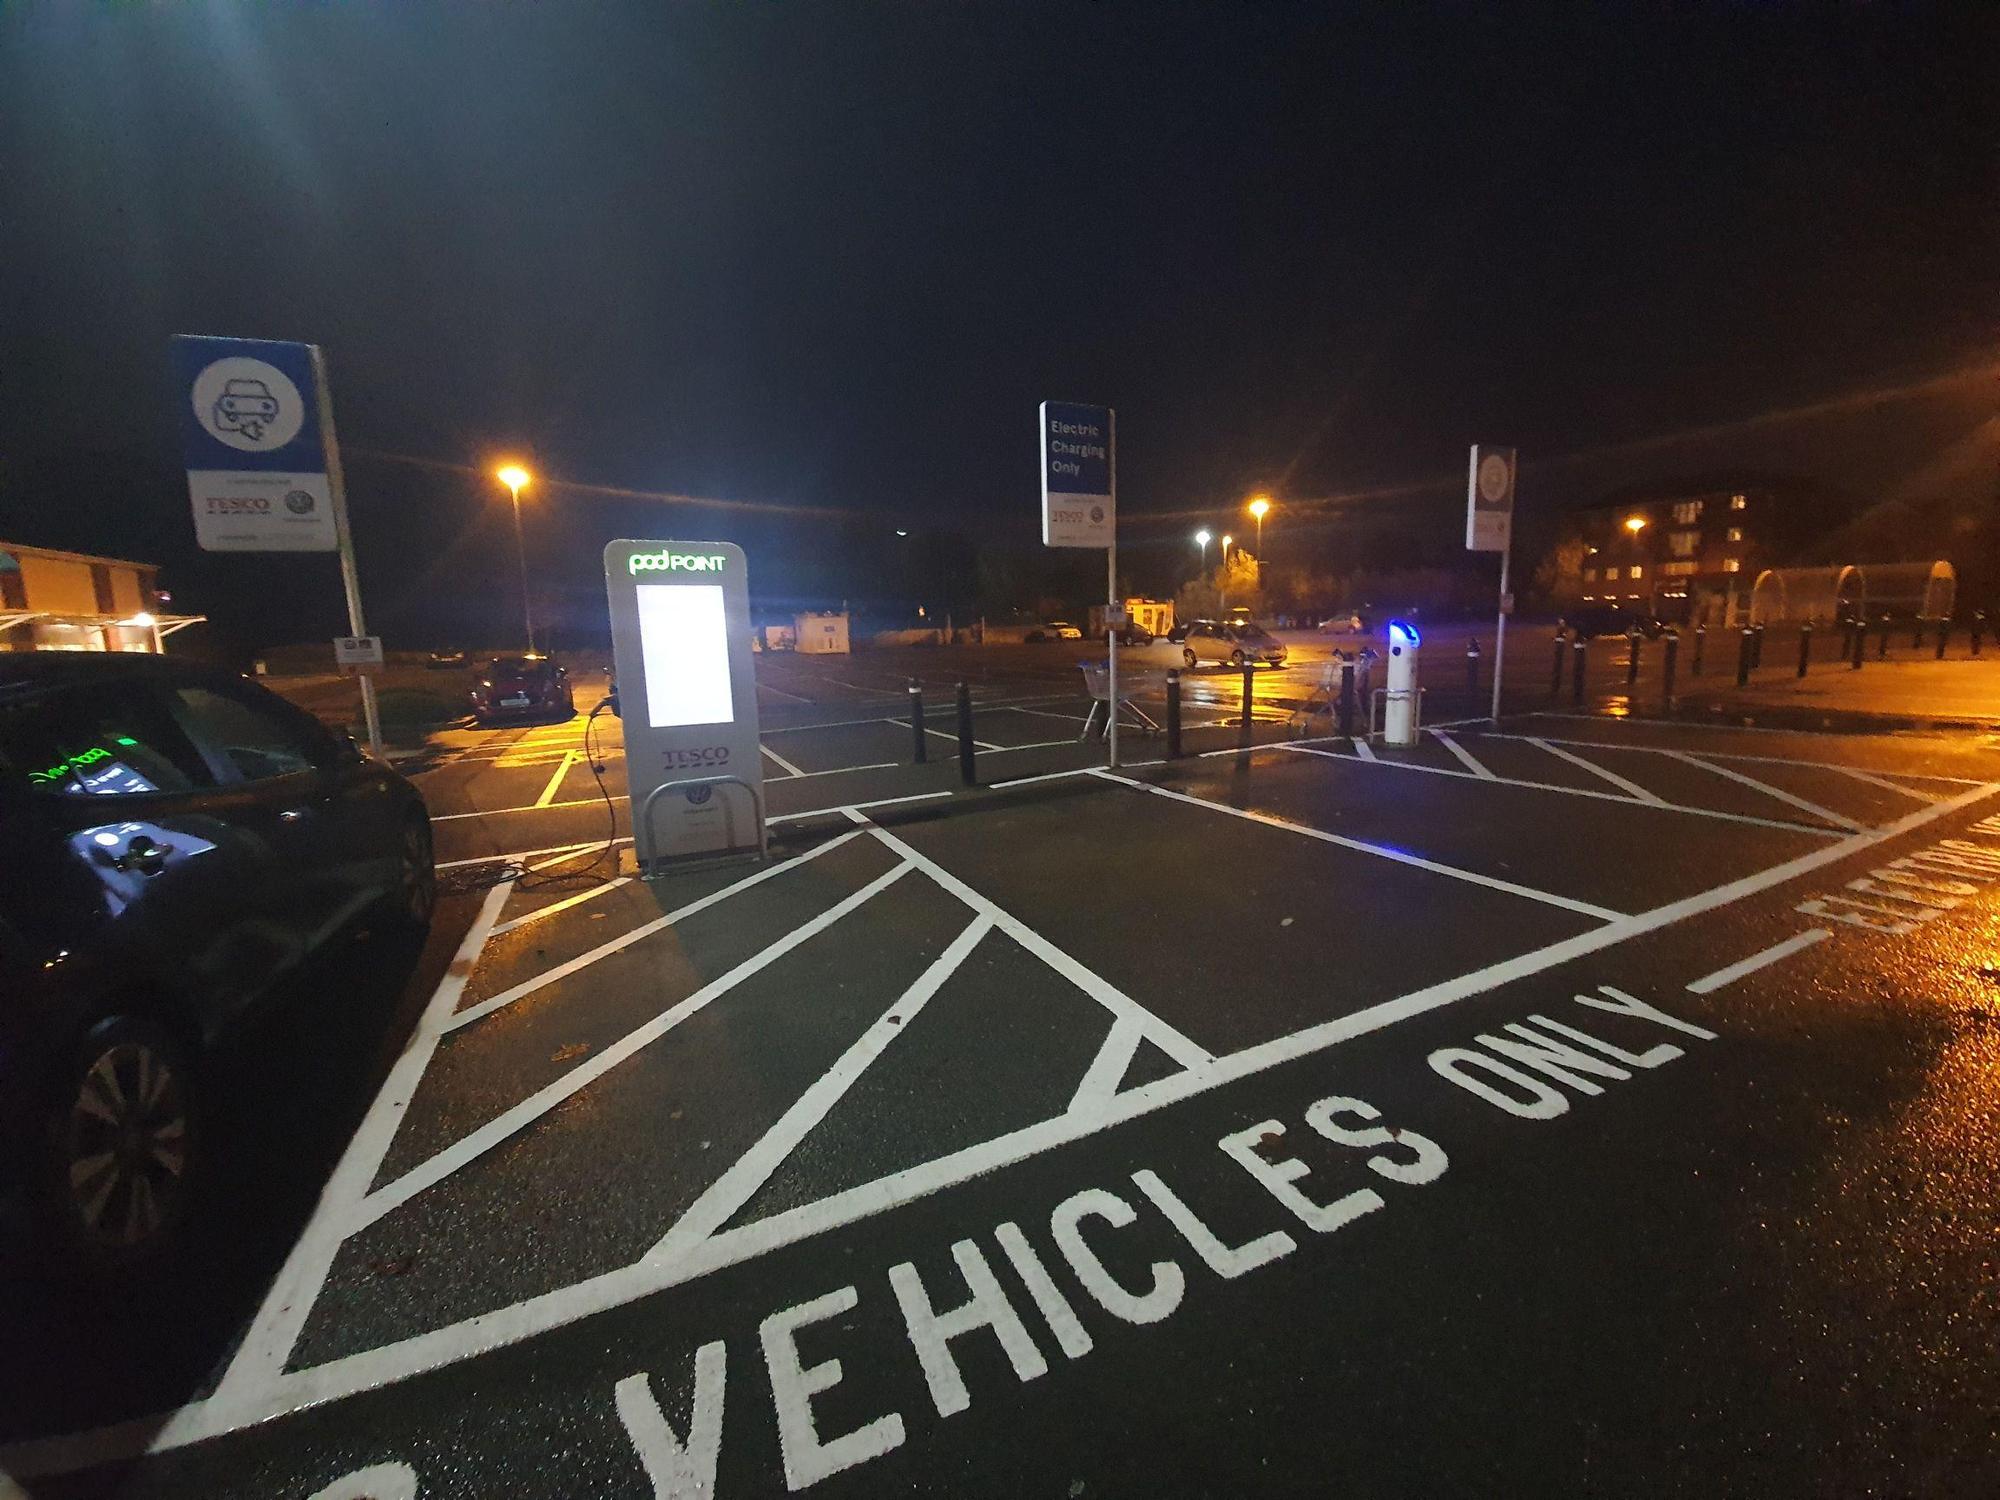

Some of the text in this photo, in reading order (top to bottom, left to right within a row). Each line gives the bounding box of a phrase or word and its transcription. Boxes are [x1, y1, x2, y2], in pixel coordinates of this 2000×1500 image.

[1051, 420, 1099, 436] Electric
[1051, 440, 1105, 459] Charging
[1052, 460, 1081, 477] Only
[206, 497, 269, 510] TESCO
[629, 549, 670, 576] pod
[662, 746, 729, 766] TESCO
[615, 985, 1719, 1500] VEHICLES ONLY
